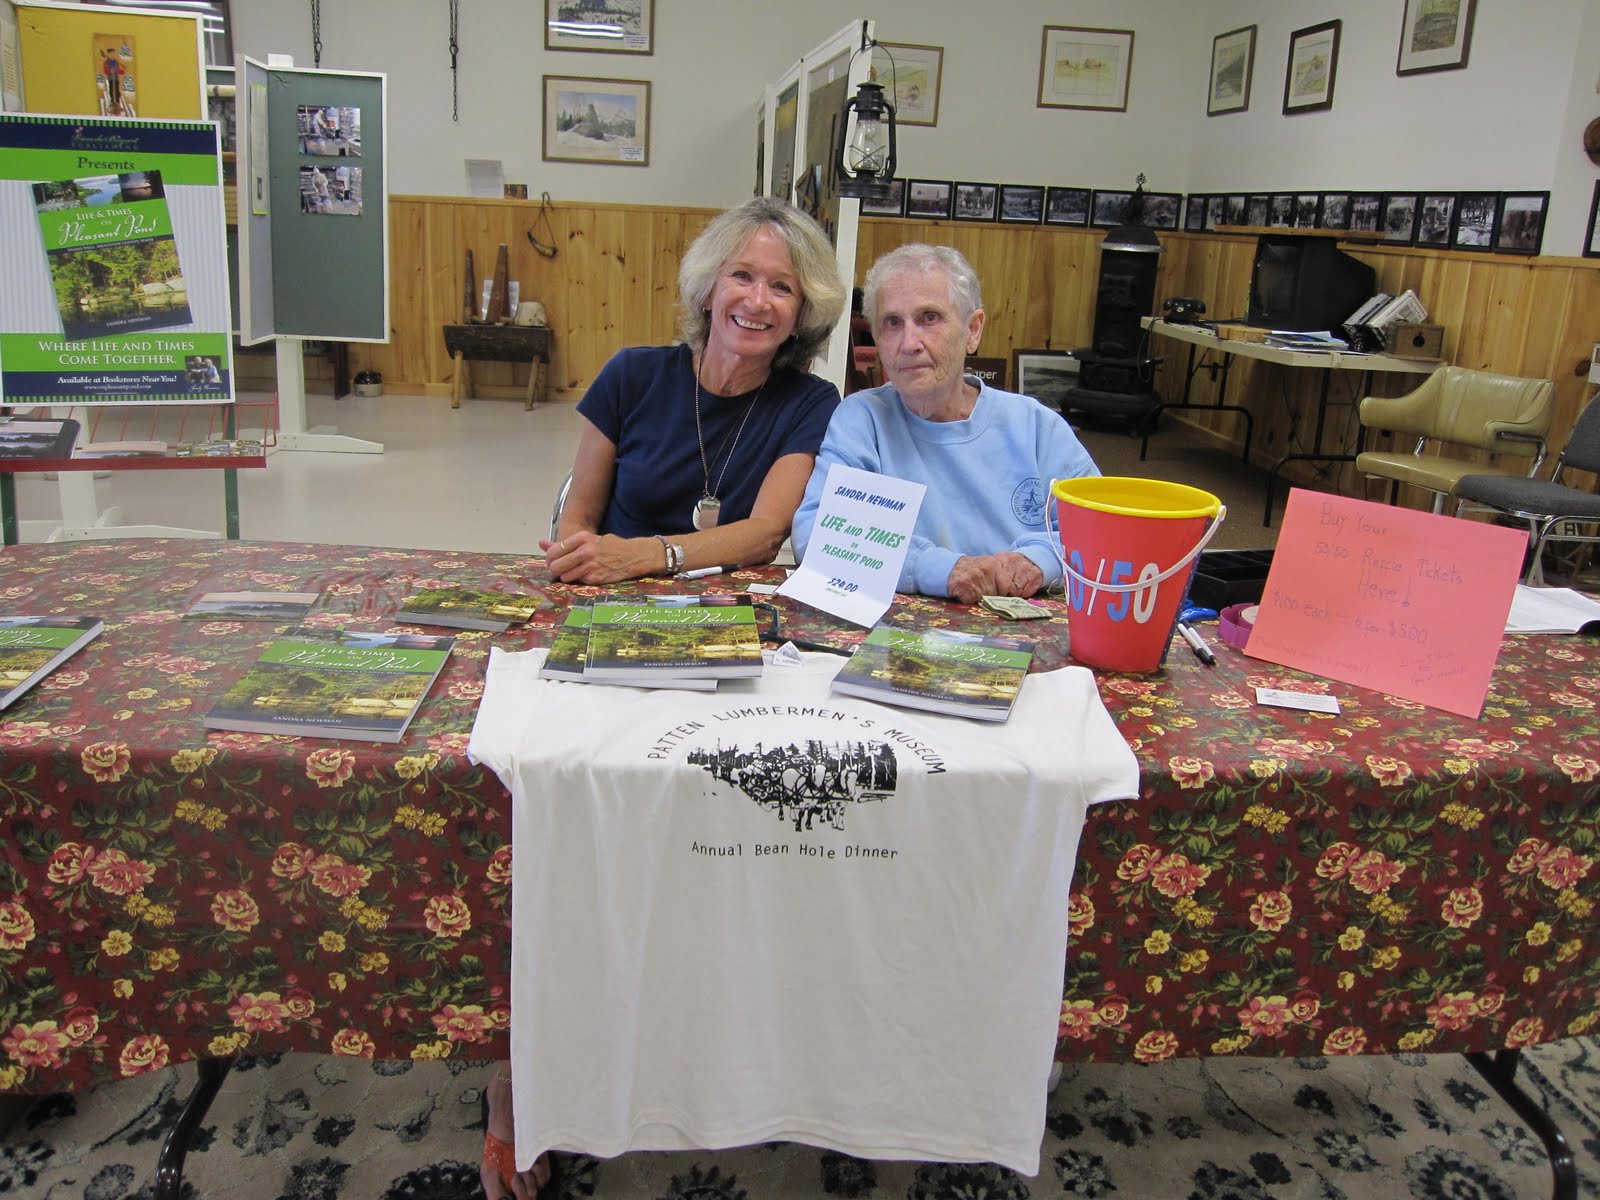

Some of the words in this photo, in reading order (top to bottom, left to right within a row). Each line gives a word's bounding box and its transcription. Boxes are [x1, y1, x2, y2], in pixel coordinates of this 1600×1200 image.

[77, 156, 135, 170] Presents
[76, 212, 95, 221] LIFE
[105, 208, 132, 217] TIMES
[58, 221, 121, 246] Pleasant
[124, 214, 159, 238] Pond
[38, 340, 87, 351] WHERE
[92, 340, 118, 351] LIFE
[122, 340, 151, 351] AND
[155, 340, 194, 351] TIMES
[59, 353, 99, 365] COME
[103, 353, 176, 365] TOGETHER.
[57, 376, 91, 384] Available
[103, 376, 141, 384] Bookstores
[142, 375, 160, 383] Near
[160, 375, 177, 383] You!
[833, 485, 866, 502] SANDRA
[866, 494, 907, 512] NEWMAN
[1320, 502, 1347, 536] Buy
[1357, 511, 1389, 535] Your
[820, 514, 848, 533] LIFE
[843, 525, 863, 537] AND
[864, 526, 906, 549] TIMES
[821, 543, 862, 563] PLEASANT
[861, 555, 884, 570] POND
[1062, 545, 1160, 624] 0/50
[321, 647, 345, 655] LIFE
[647, 720, 706, 760] PATTEN
[883, 728, 947, 775] MUSEUM
[691, 841, 743, 857] Annual
[754, 843, 789, 856] Bean
[799, 843, 836, 859] Hole
[845, 845, 898, 860] Dinner
